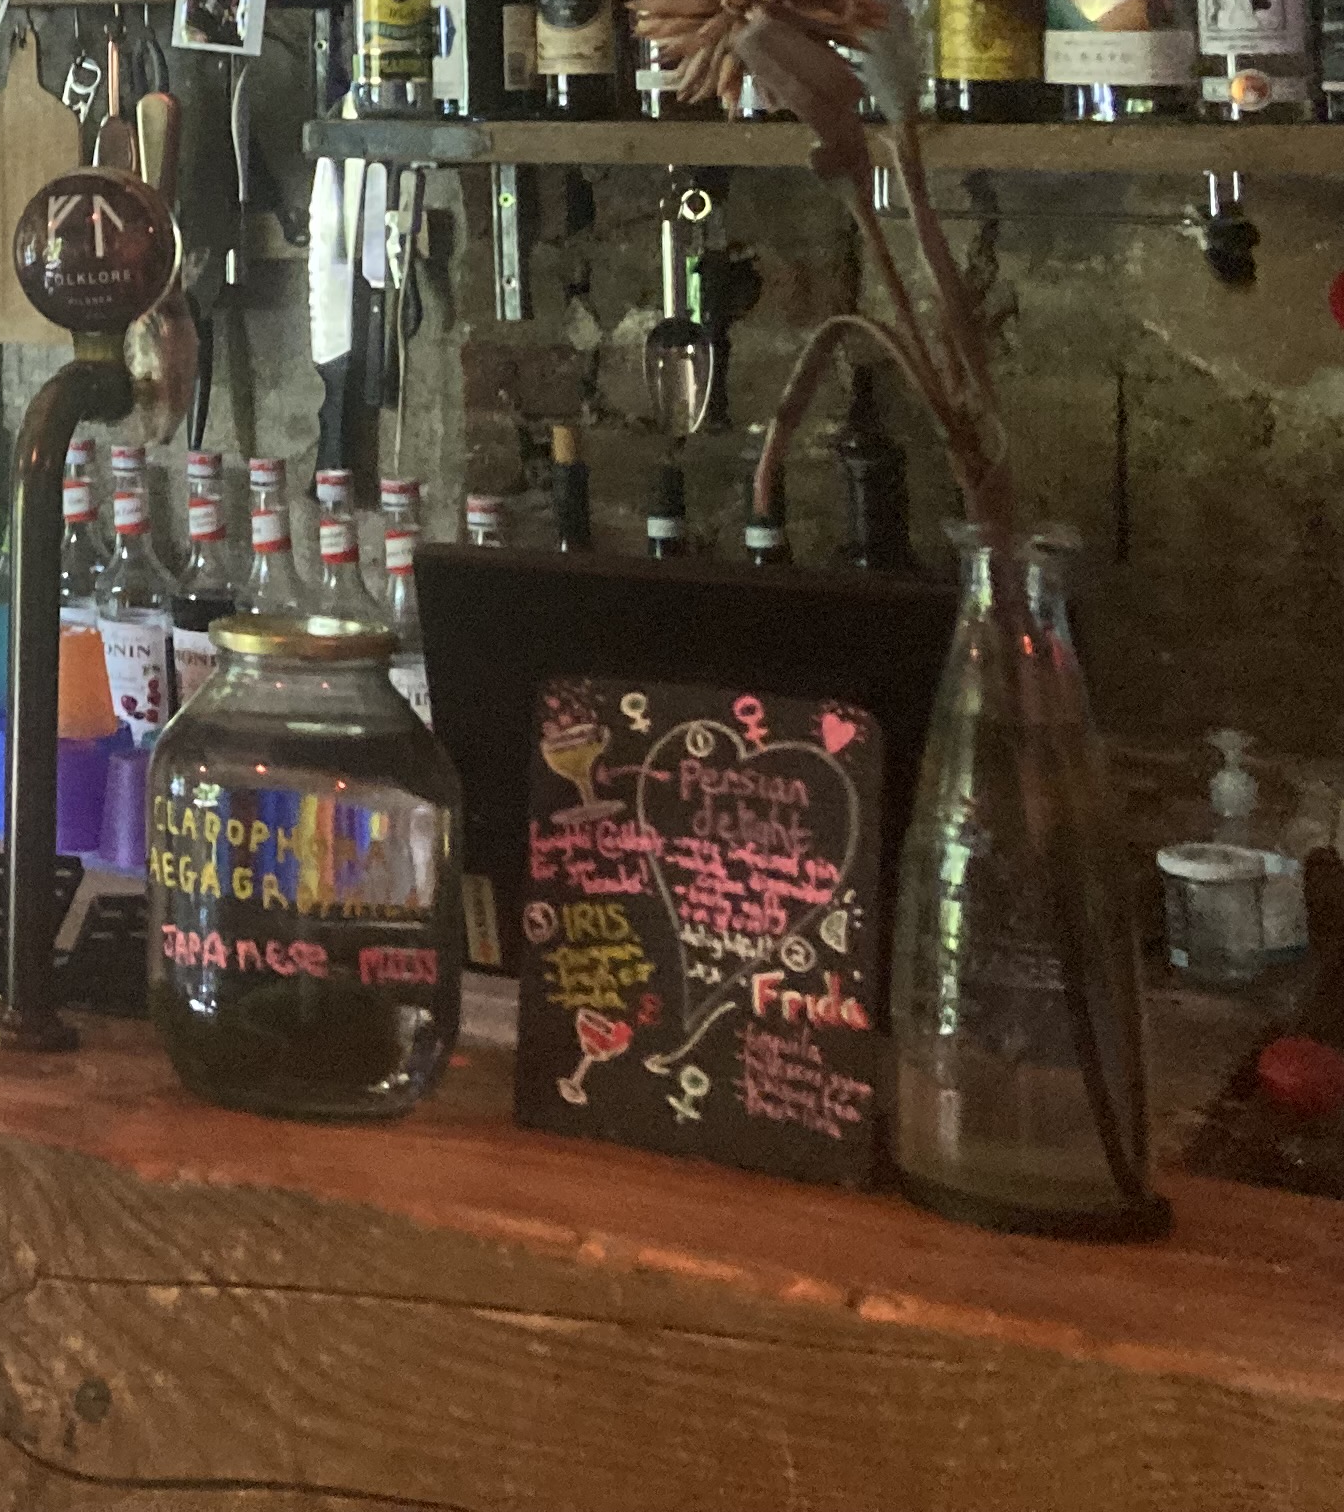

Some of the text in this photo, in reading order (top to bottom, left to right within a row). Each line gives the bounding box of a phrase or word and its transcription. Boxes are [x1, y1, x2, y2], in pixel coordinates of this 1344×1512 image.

[44, 268, 132, 289] FOLKLORE
[563, 902, 630, 942] IRIS
[752, 970, 871, 1032] Frida
